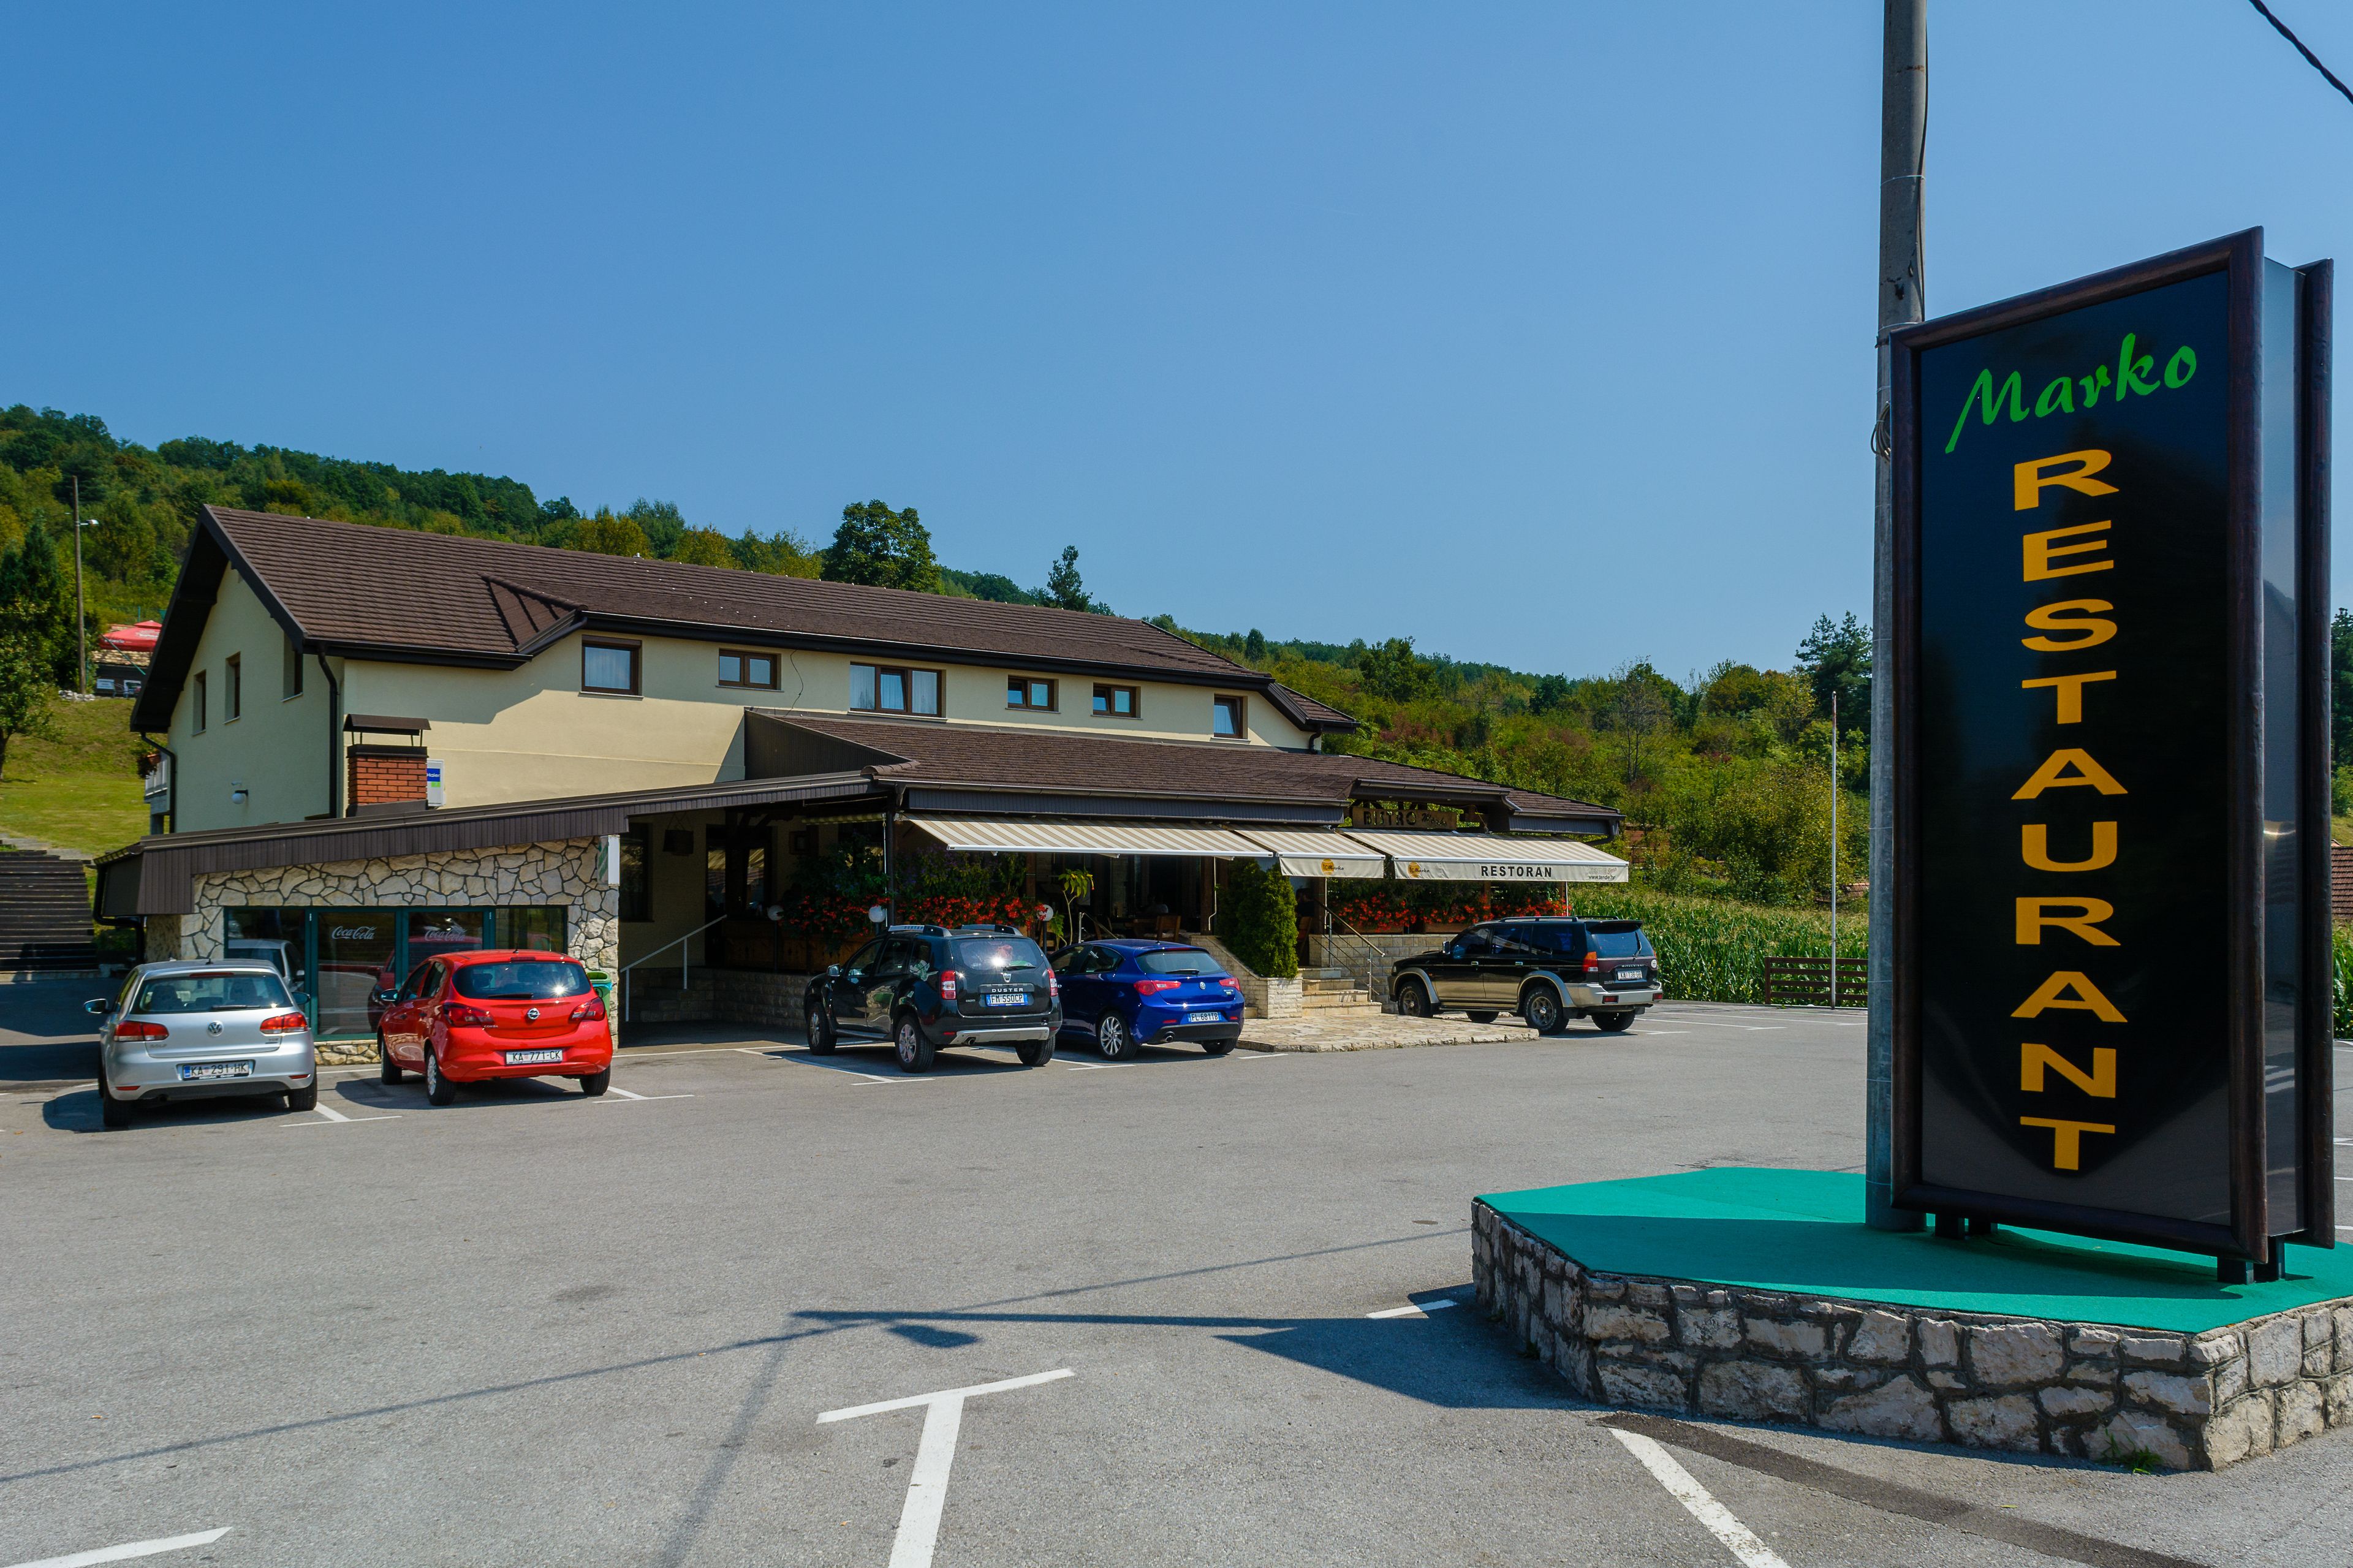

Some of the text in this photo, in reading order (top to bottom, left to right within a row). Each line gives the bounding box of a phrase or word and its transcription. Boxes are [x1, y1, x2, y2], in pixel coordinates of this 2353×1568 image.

[1945, 333, 2197, 454] Marko
[2011, 449, 2128, 1171] RESTAURANT
[1363, 811, 1417, 826] BISTRO
[1481, 865, 1552, 877] RESTORAN
[991, 994, 1001, 1004] FM
[512, 1050, 560, 1061] KA 771-CK
[191, 1062, 247, 1076] KA 291-HK
